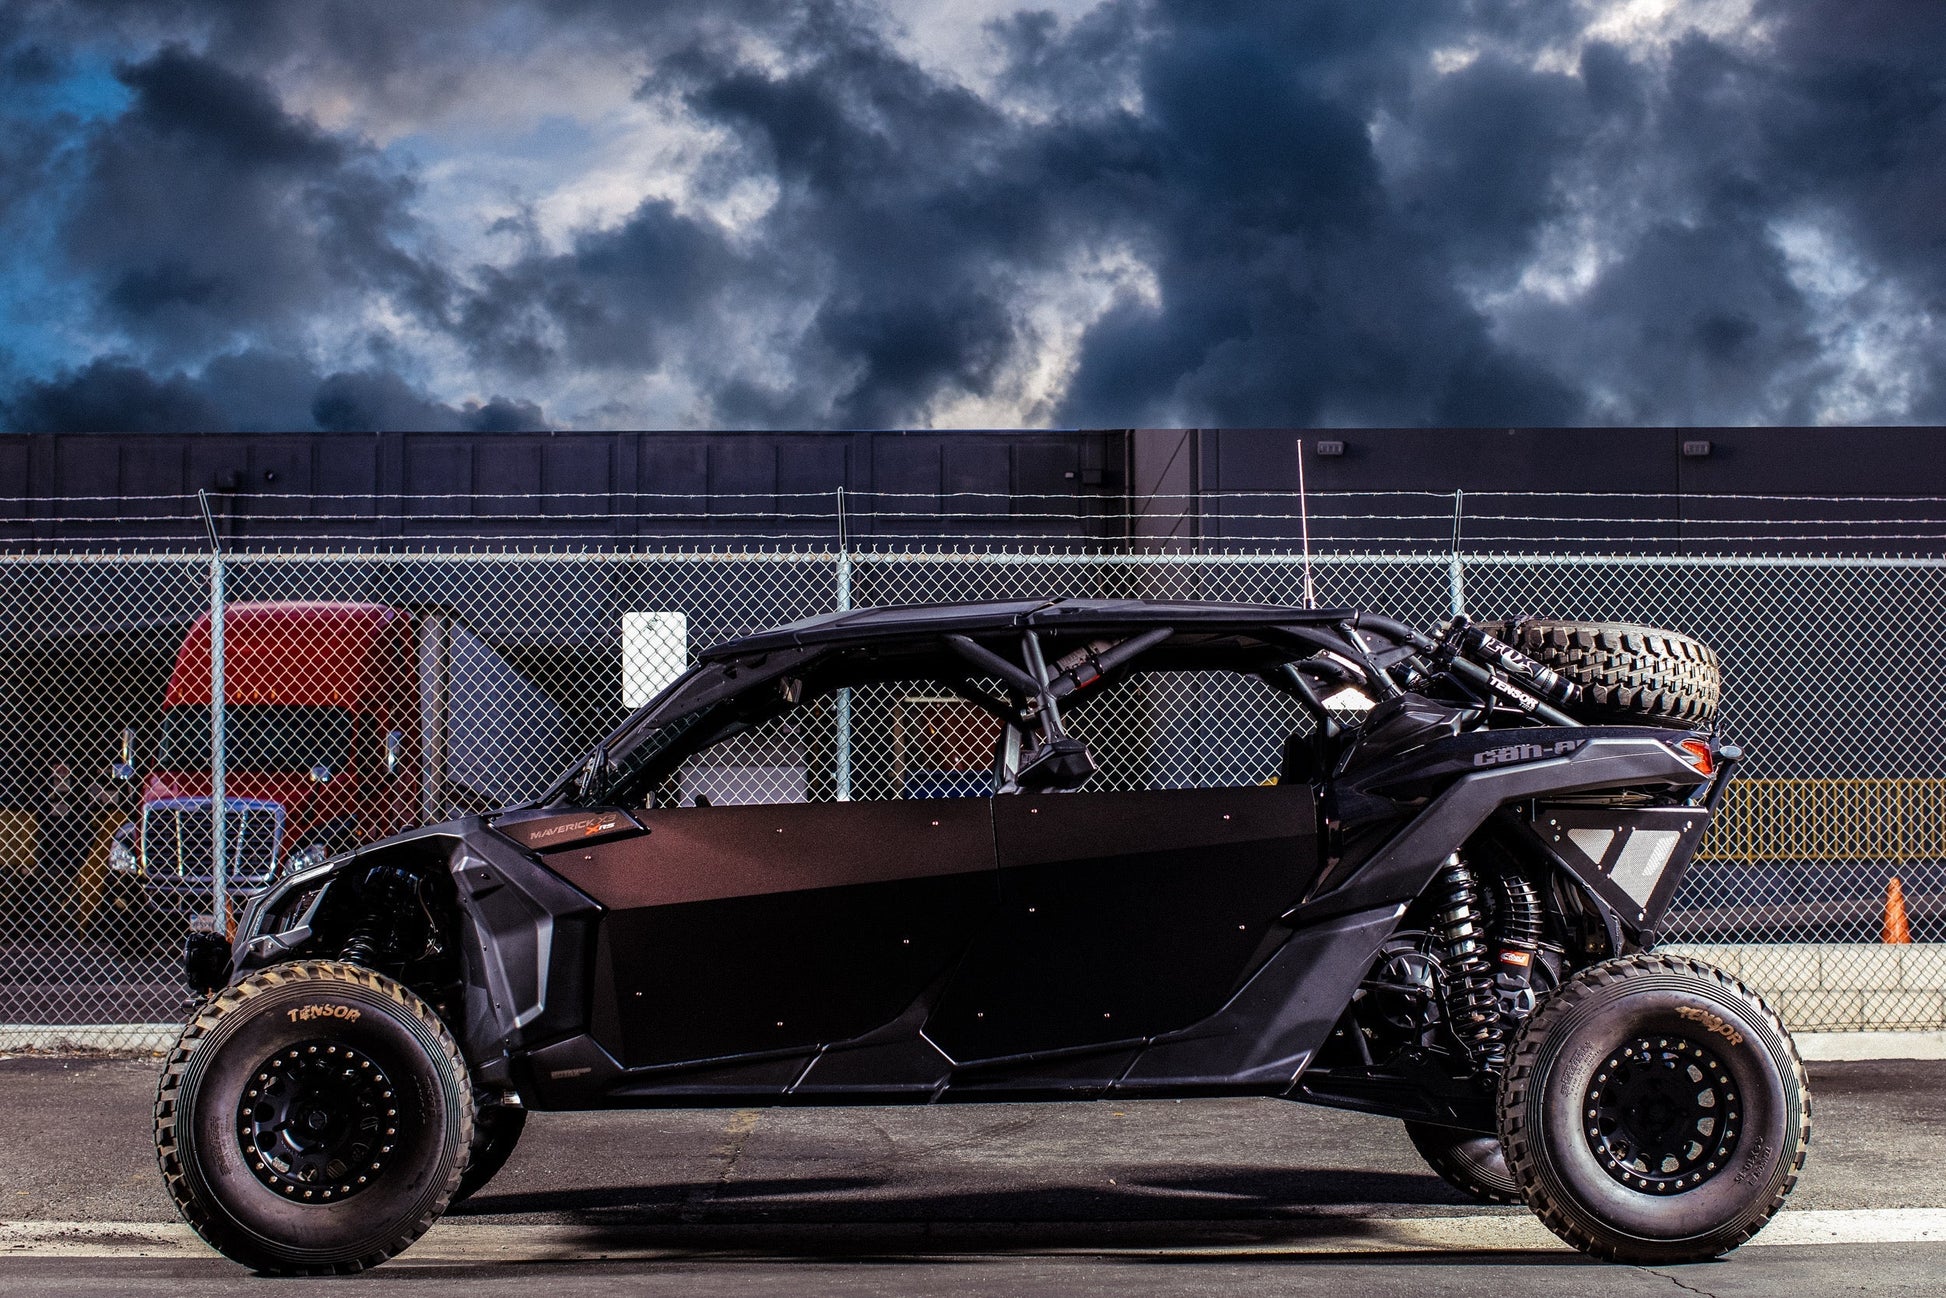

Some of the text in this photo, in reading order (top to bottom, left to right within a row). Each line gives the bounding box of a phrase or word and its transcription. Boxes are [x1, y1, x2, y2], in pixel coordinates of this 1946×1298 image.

[1486, 637, 1537, 674] FOX
[1489, 676, 1539, 707] TENSOR
[1473, 740, 1586, 766] can-a
[530, 814, 617, 840] MAVERICK X3
[287, 1003, 361, 1023] TENSOR
[1674, 1006, 1743, 1046] TENSOR
